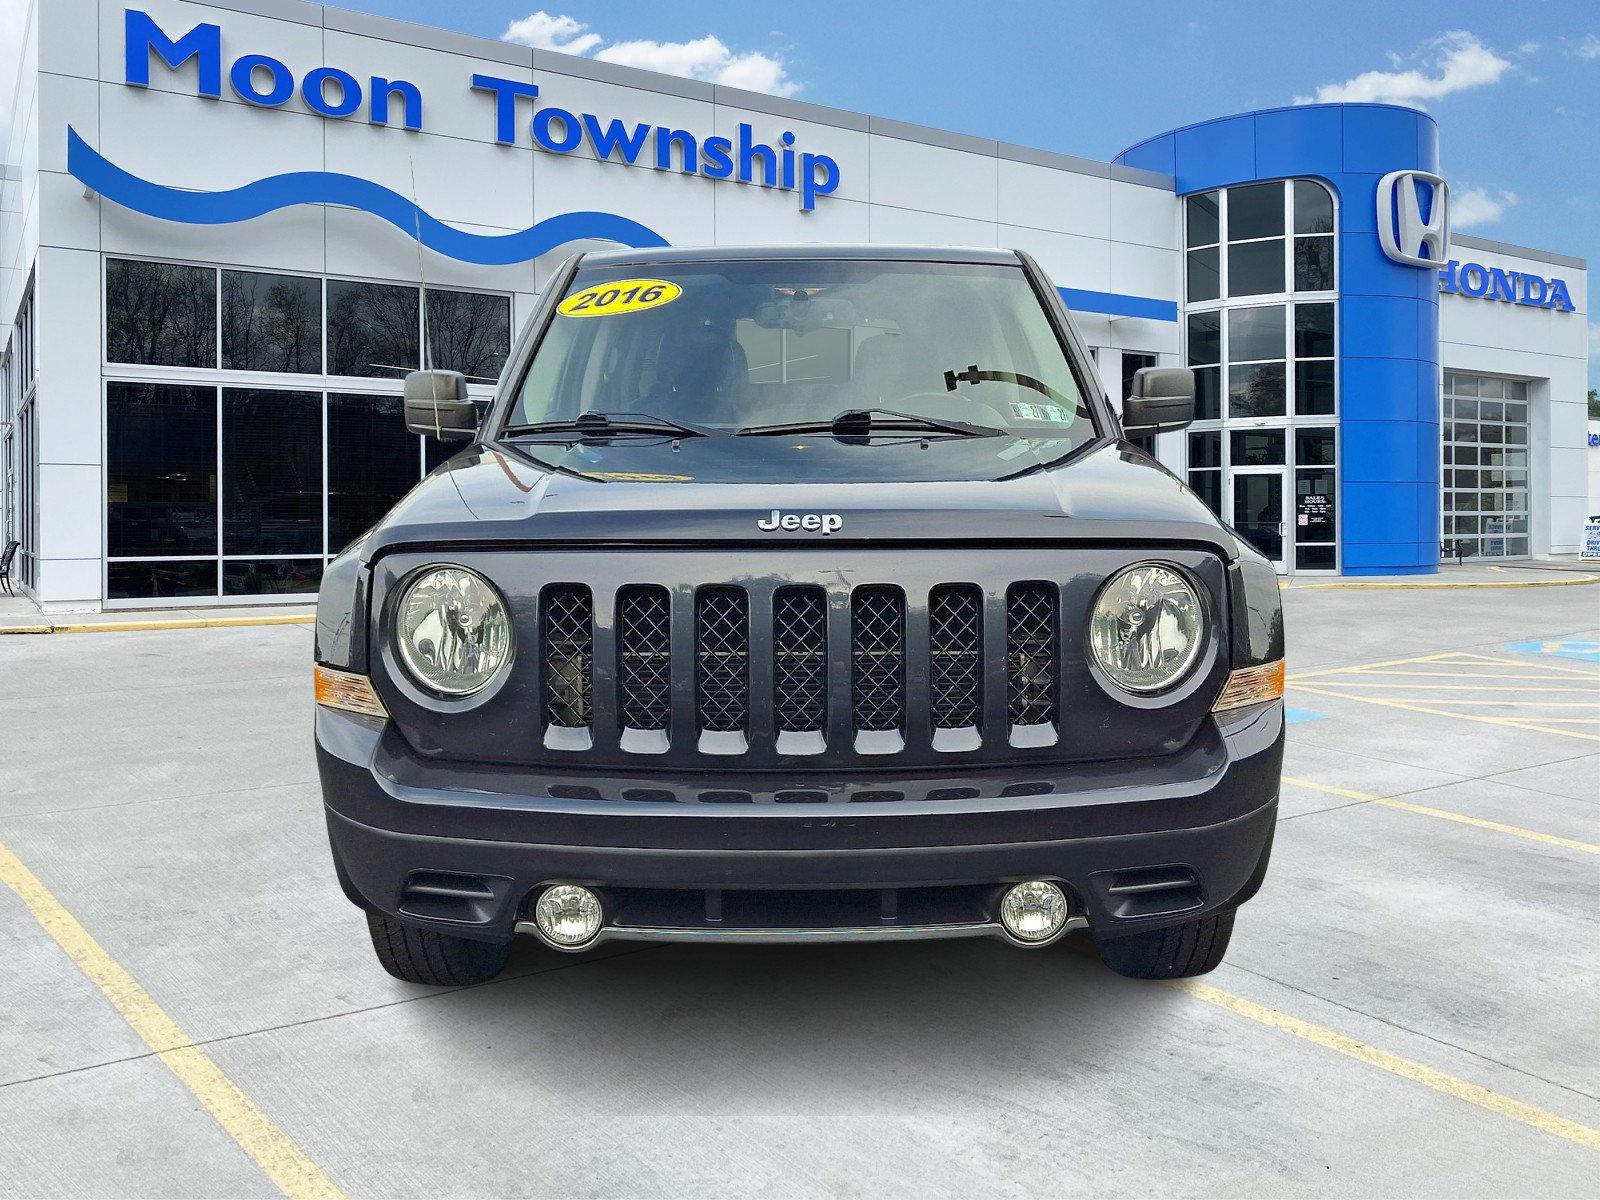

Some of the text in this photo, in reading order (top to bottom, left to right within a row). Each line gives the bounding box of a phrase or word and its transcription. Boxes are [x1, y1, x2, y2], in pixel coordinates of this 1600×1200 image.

[125, 9, 840, 212] Moon Township
[568, 285, 667, 312] 2016
[1438, 260, 1576, 312] HONDA
[757, 510, 843, 536] Jeep
